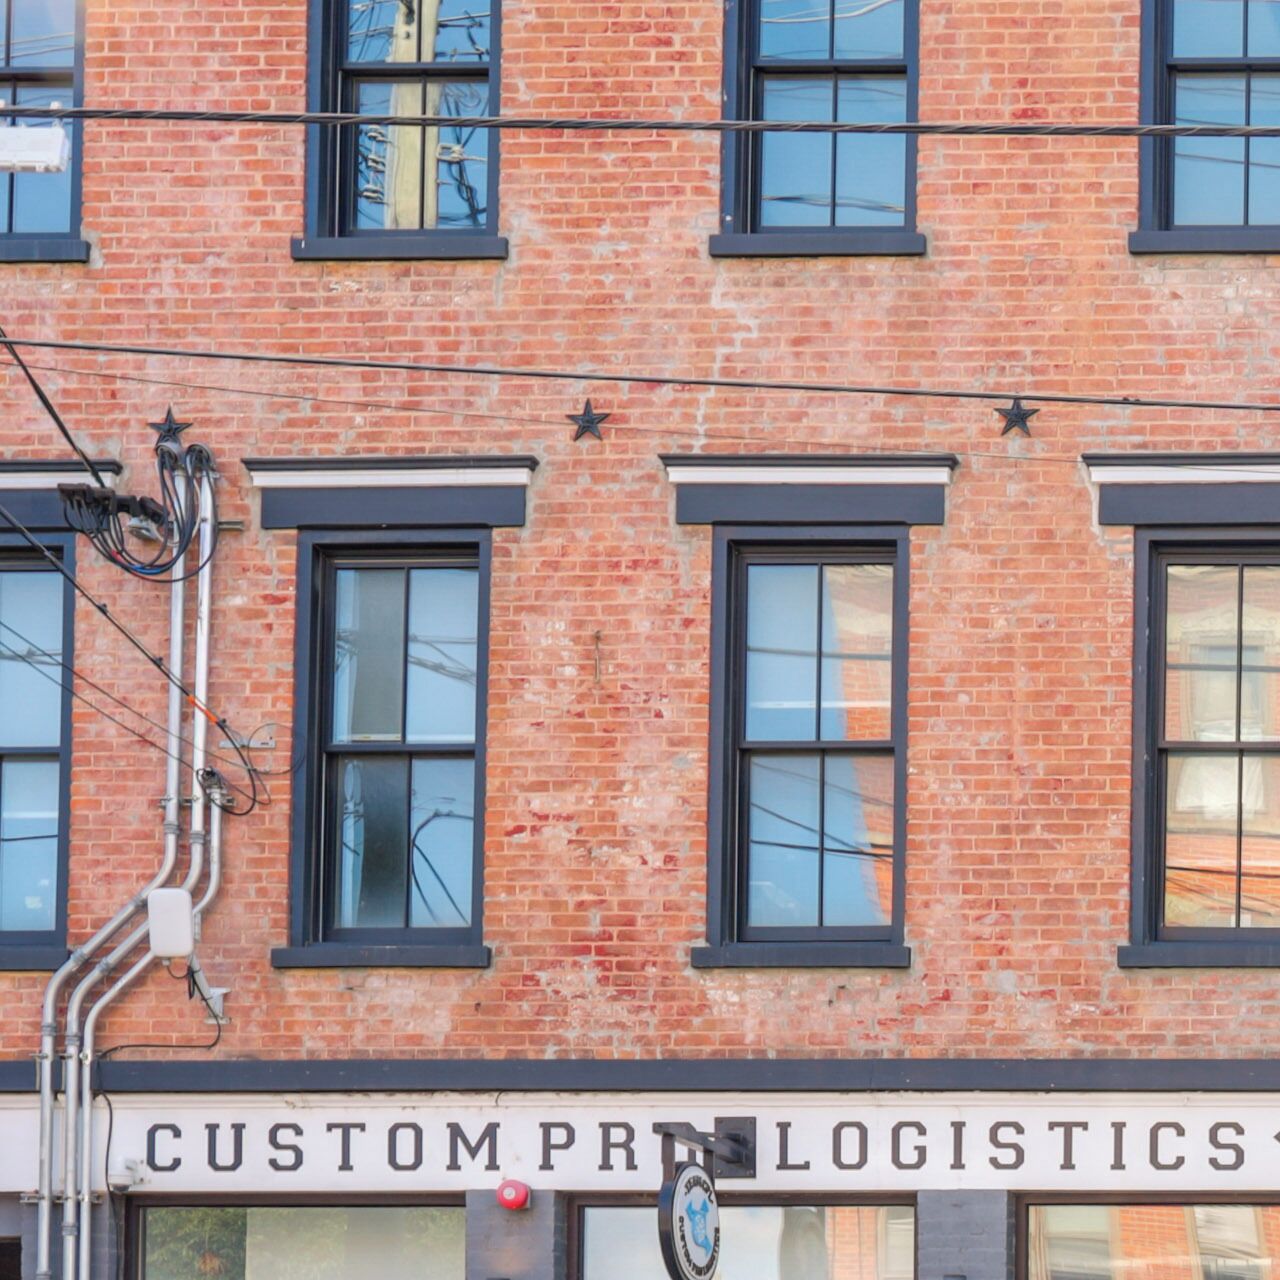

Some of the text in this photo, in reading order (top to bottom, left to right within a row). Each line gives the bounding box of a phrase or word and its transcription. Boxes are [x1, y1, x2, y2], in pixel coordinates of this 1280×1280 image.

[146, 1120, 1247, 1172] CUSTOM PR LOGISTICS
